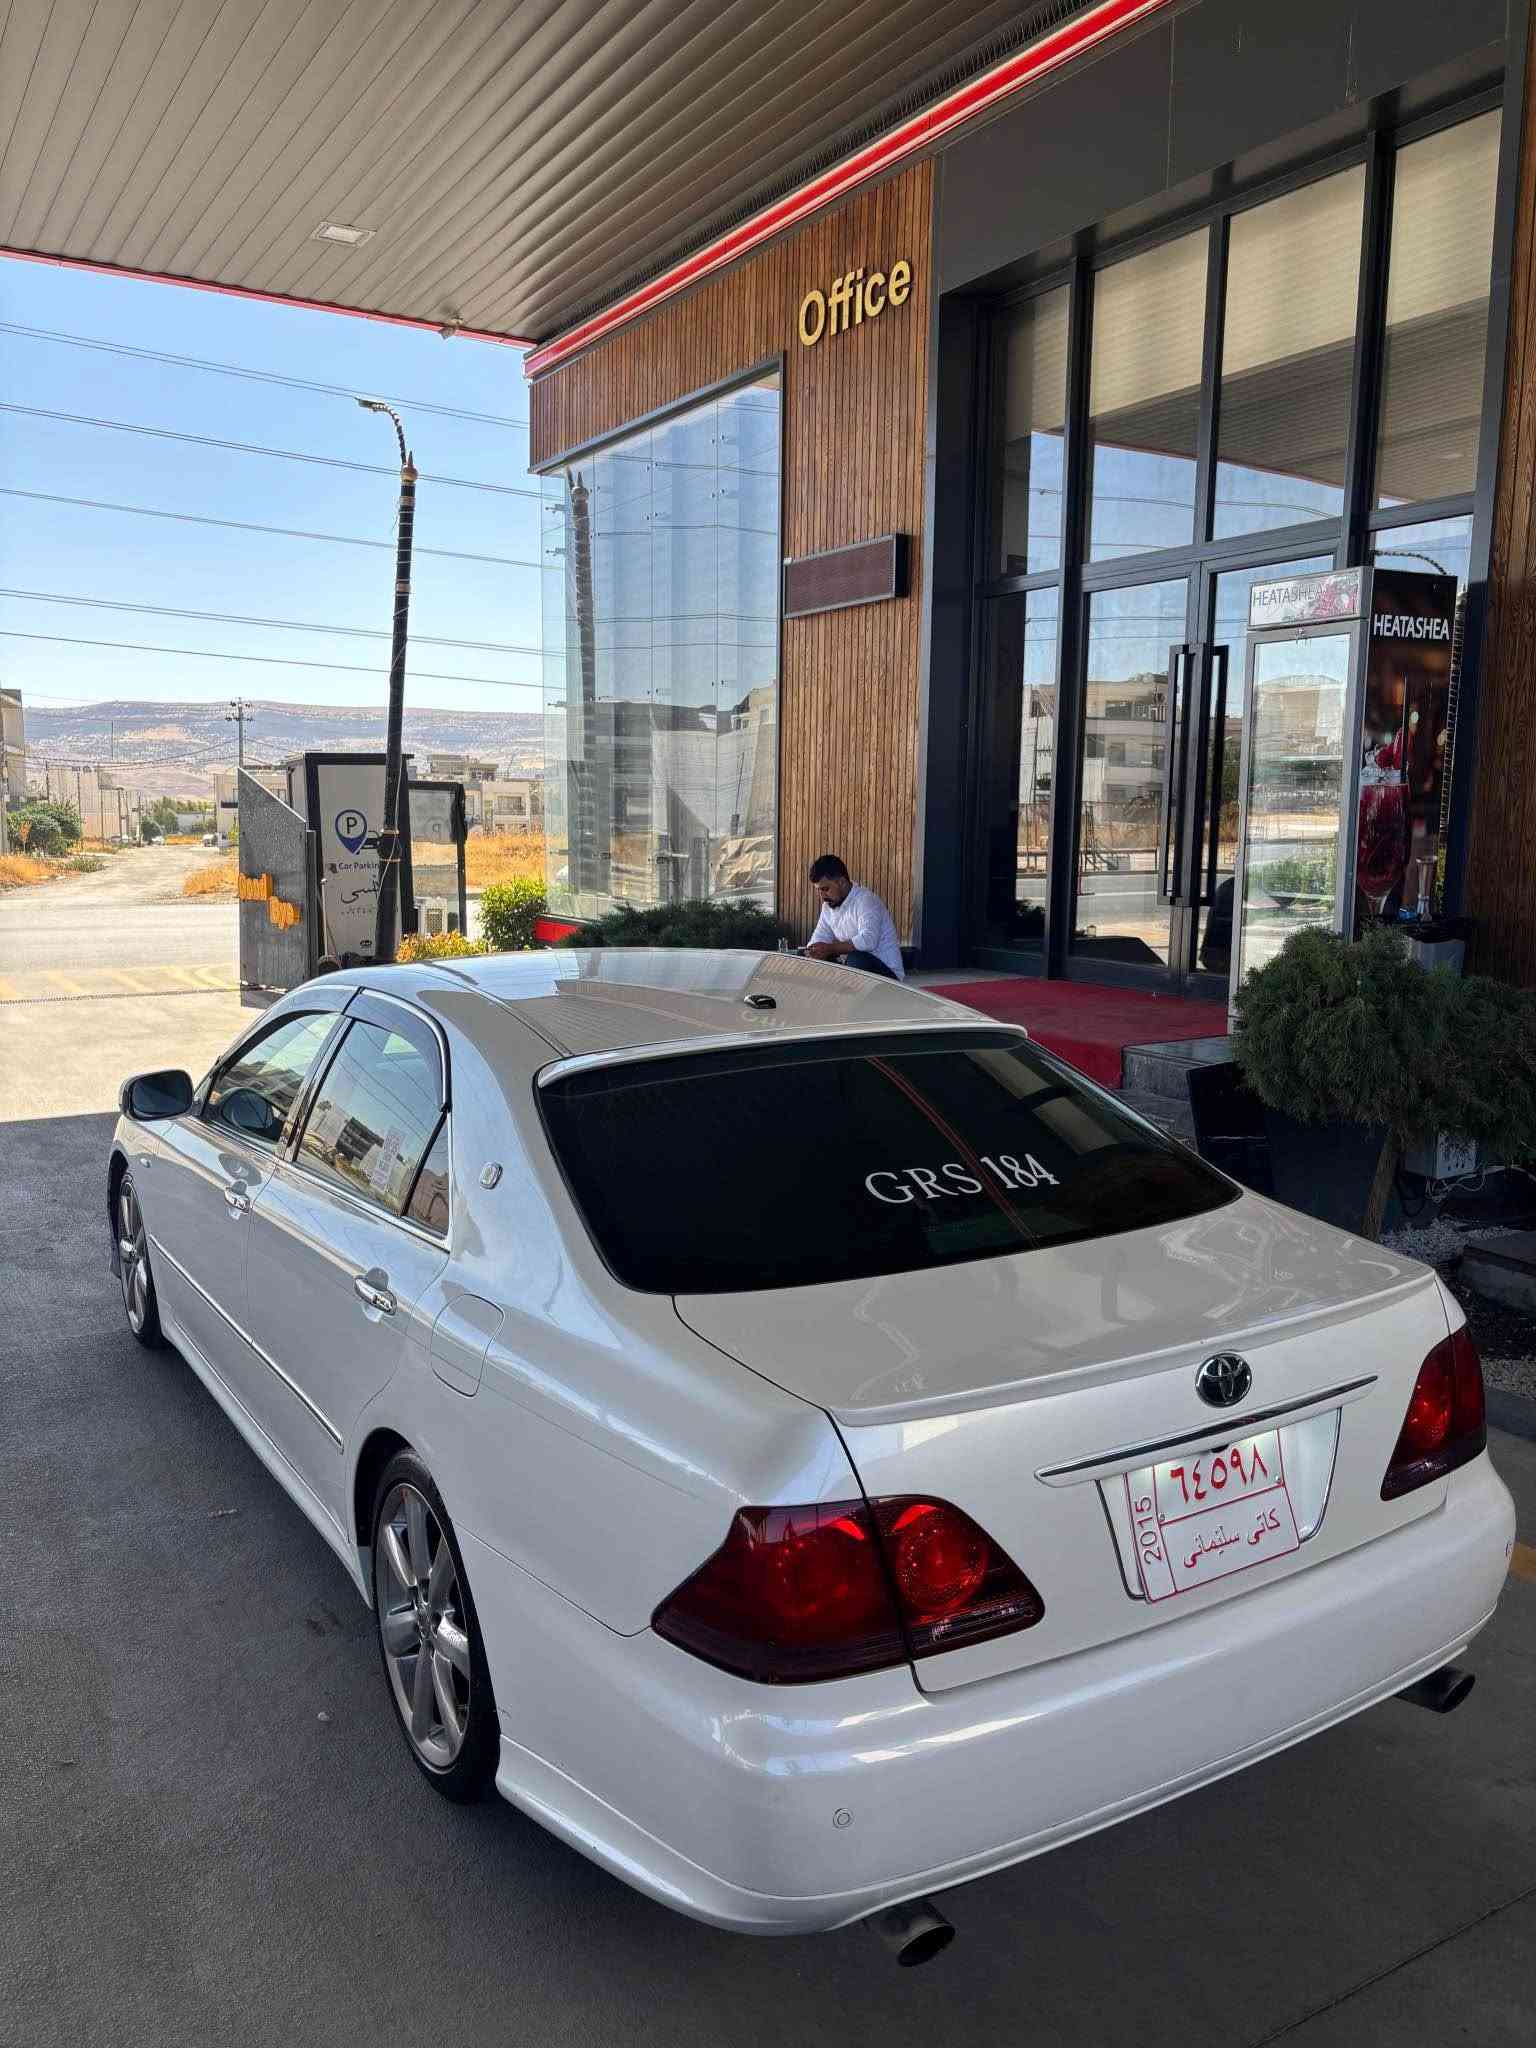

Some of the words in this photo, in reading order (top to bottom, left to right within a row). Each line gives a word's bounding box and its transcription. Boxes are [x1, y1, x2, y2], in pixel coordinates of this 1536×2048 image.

[799, 260, 911, 346] Office
[1374, 614, 1450, 640] HEATASHEA
[345, 817, 358, 834] P
[338, 862, 352, 870] Car
[865, 1163, 982, 1203] GRS
[980, 1153, 1060, 1189] 184
[1170, 1444, 1268, 1504] ٦٤٥٩٨
[1135, 1496, 1162, 1564] 2015
